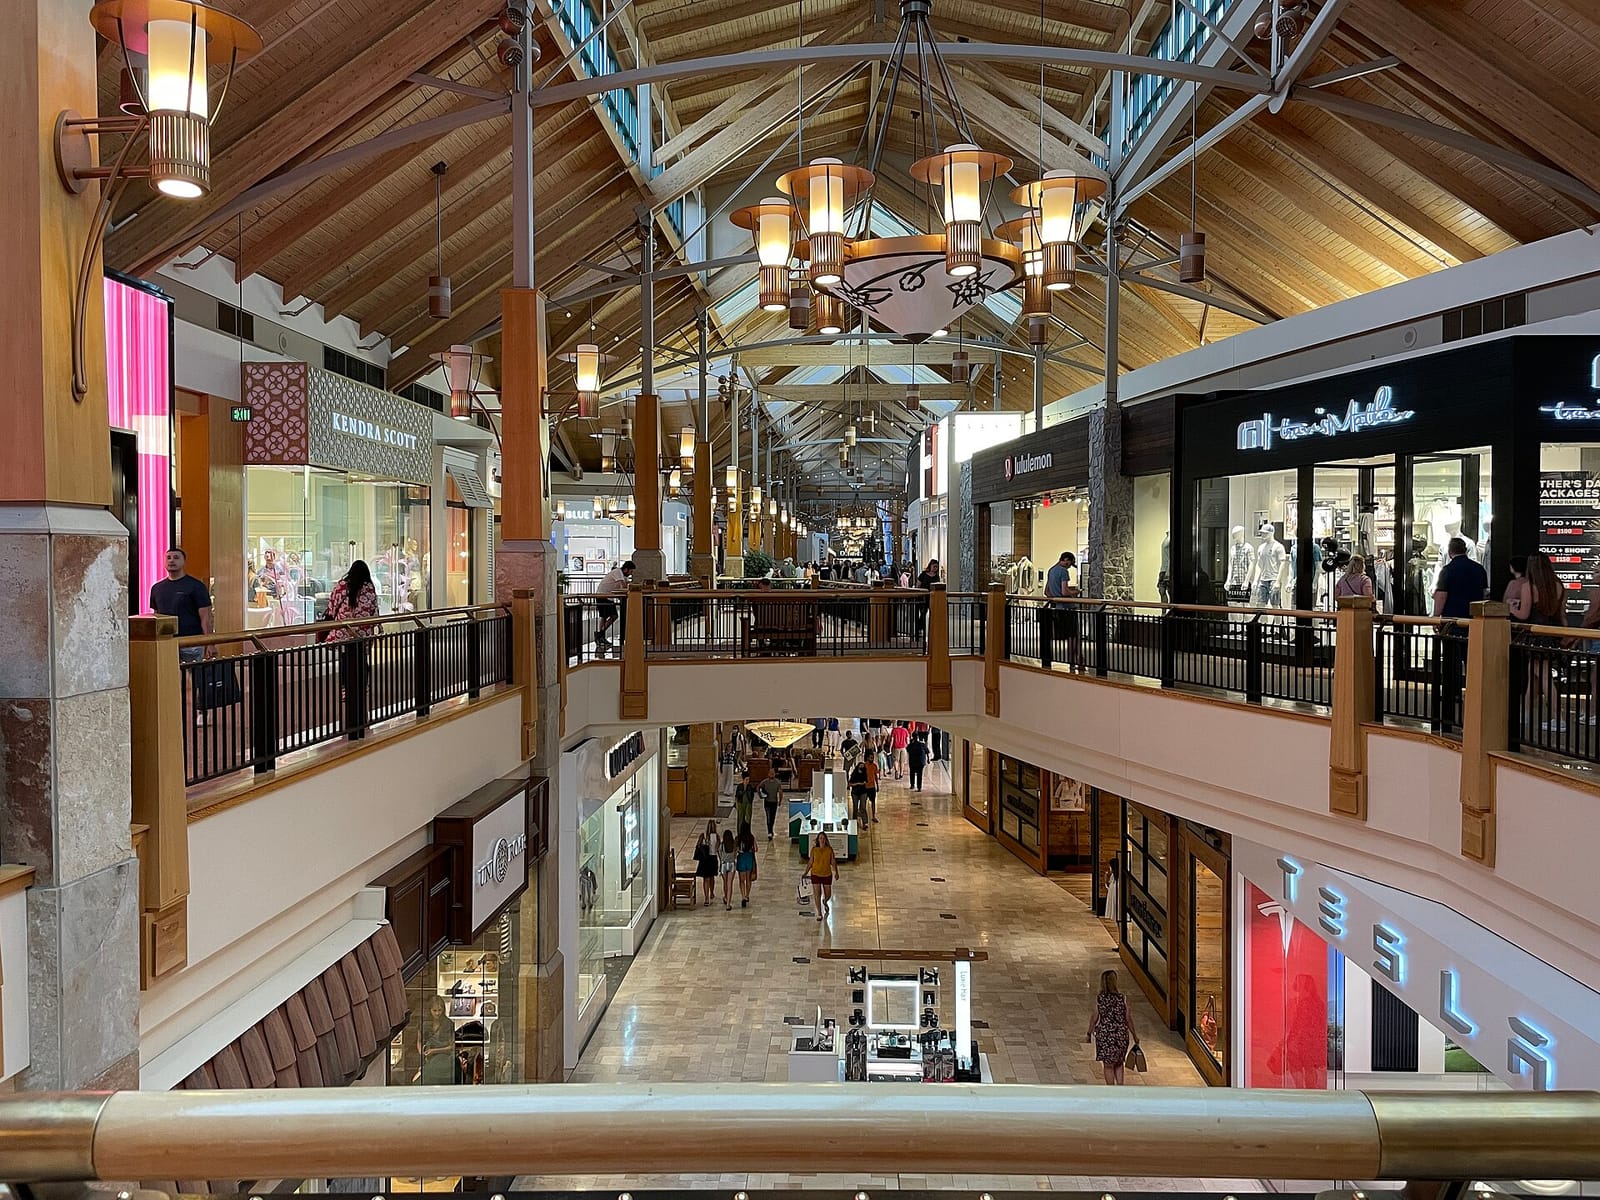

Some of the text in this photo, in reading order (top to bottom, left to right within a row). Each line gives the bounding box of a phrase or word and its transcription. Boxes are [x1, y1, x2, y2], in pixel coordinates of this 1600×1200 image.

[233, 409, 251, 421] EXIT
[332, 411, 417, 451] KENDRA SCOTT
[1014, 452, 1053, 475] lululemon
[1539, 489, 1600, 498] ACKAGES
[565, 510, 590, 520] BLUE
[1277, 856, 1554, 1090] TESLA
